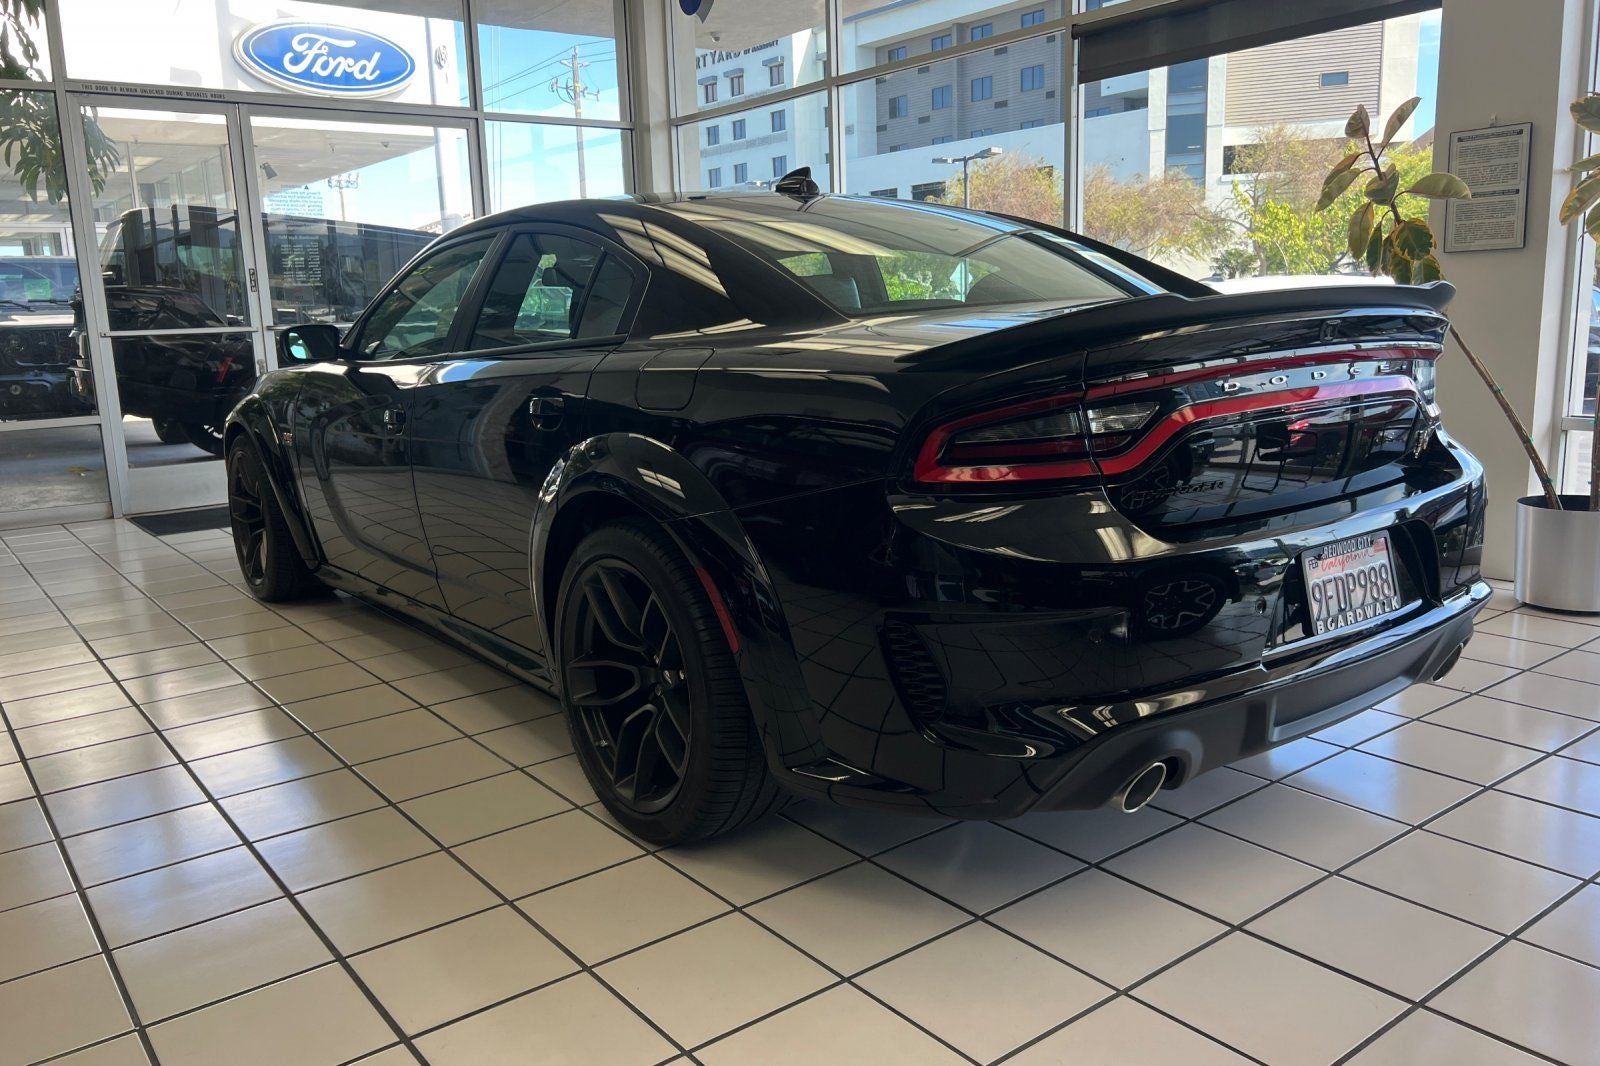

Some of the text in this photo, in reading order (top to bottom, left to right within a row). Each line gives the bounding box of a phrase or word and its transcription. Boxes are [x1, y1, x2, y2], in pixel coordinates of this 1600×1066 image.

[283, 33, 381, 81] Ford
[1223, 364, 1390, 392] DODGE
[1321, 548, 1375, 572] California
[1324, 535, 1372, 558] REDWOOD CITY
[1311, 563, 1391, 620] 9FDP988
[1316, 596, 1399, 635] BOARDWALK
